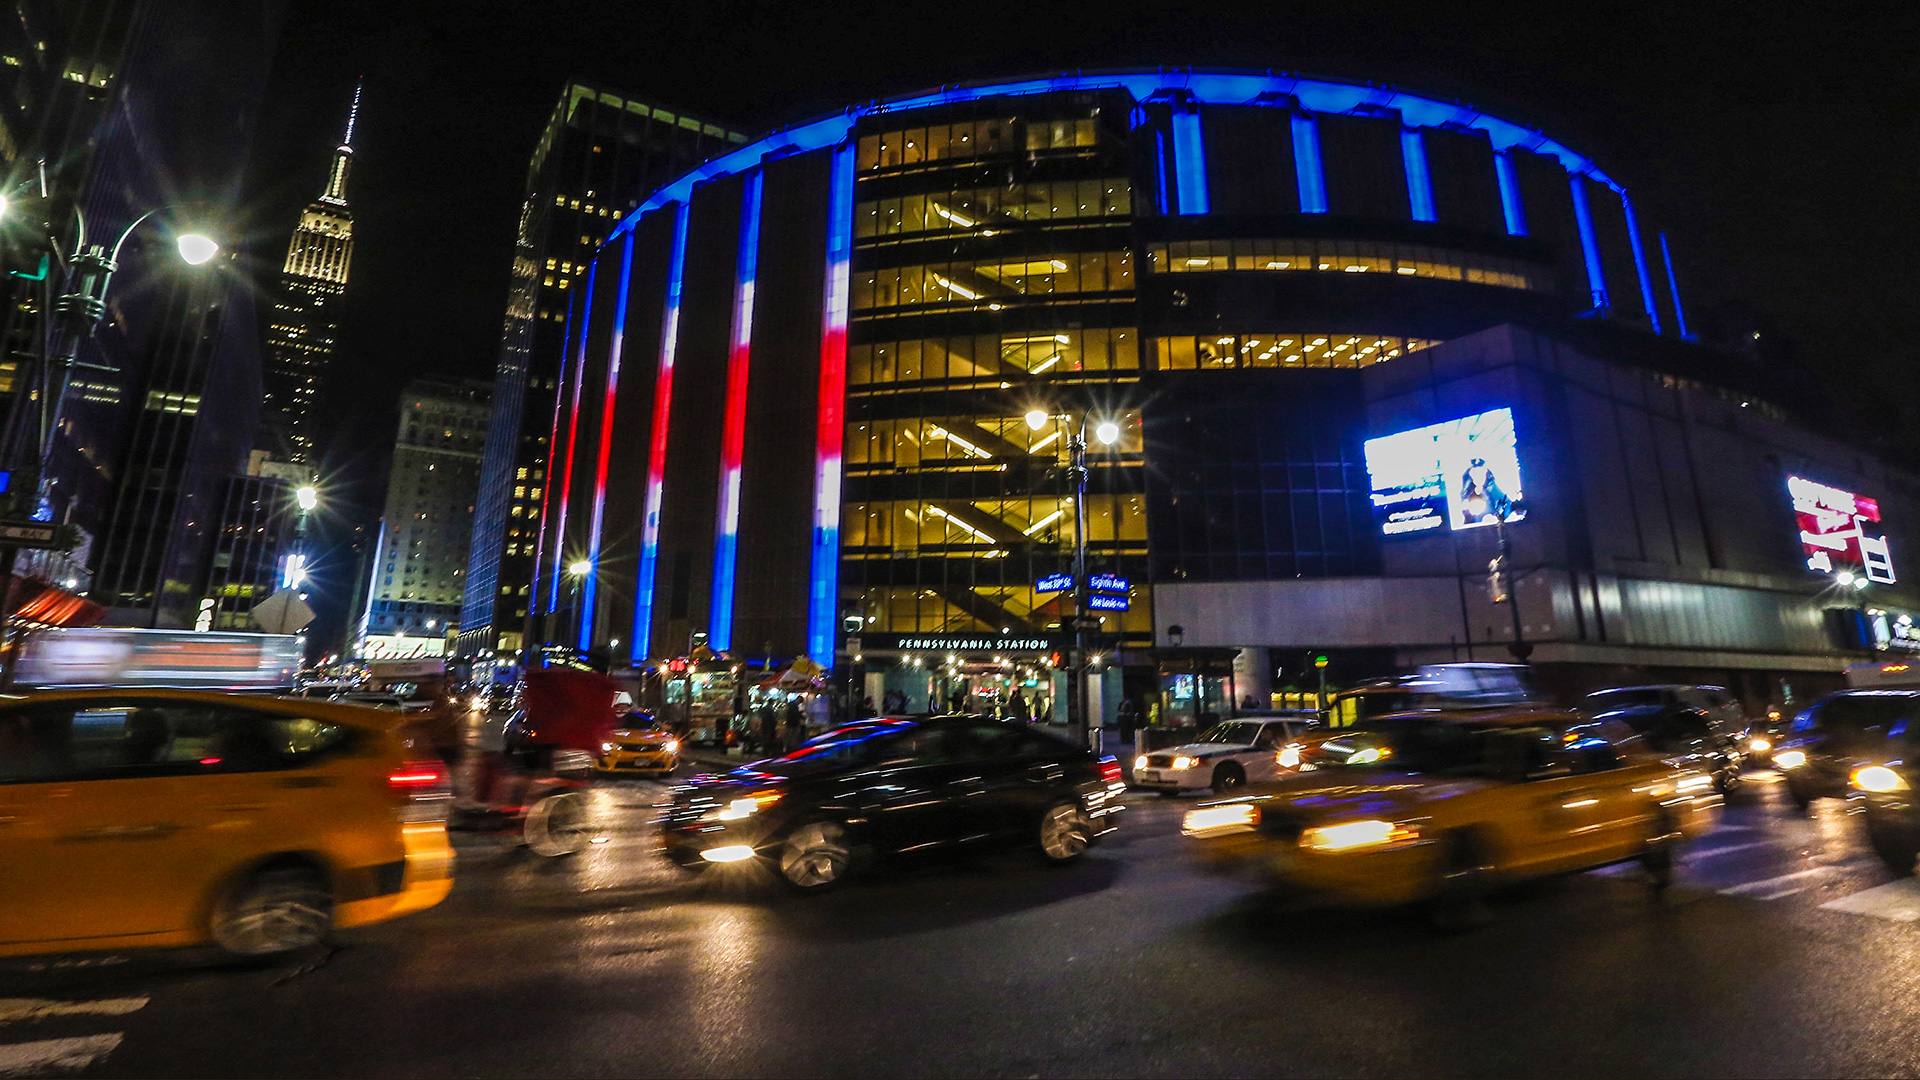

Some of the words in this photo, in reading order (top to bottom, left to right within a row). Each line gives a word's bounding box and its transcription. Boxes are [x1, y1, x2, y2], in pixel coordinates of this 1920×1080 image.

[1038, 580, 1053, 590] West
[1091, 576, 1112, 589] Eighth
[1112, 578, 1126, 590] Ave
[898, 638, 992, 650] PENNSYLVANIA
[996, 639, 1049, 650] STATION
